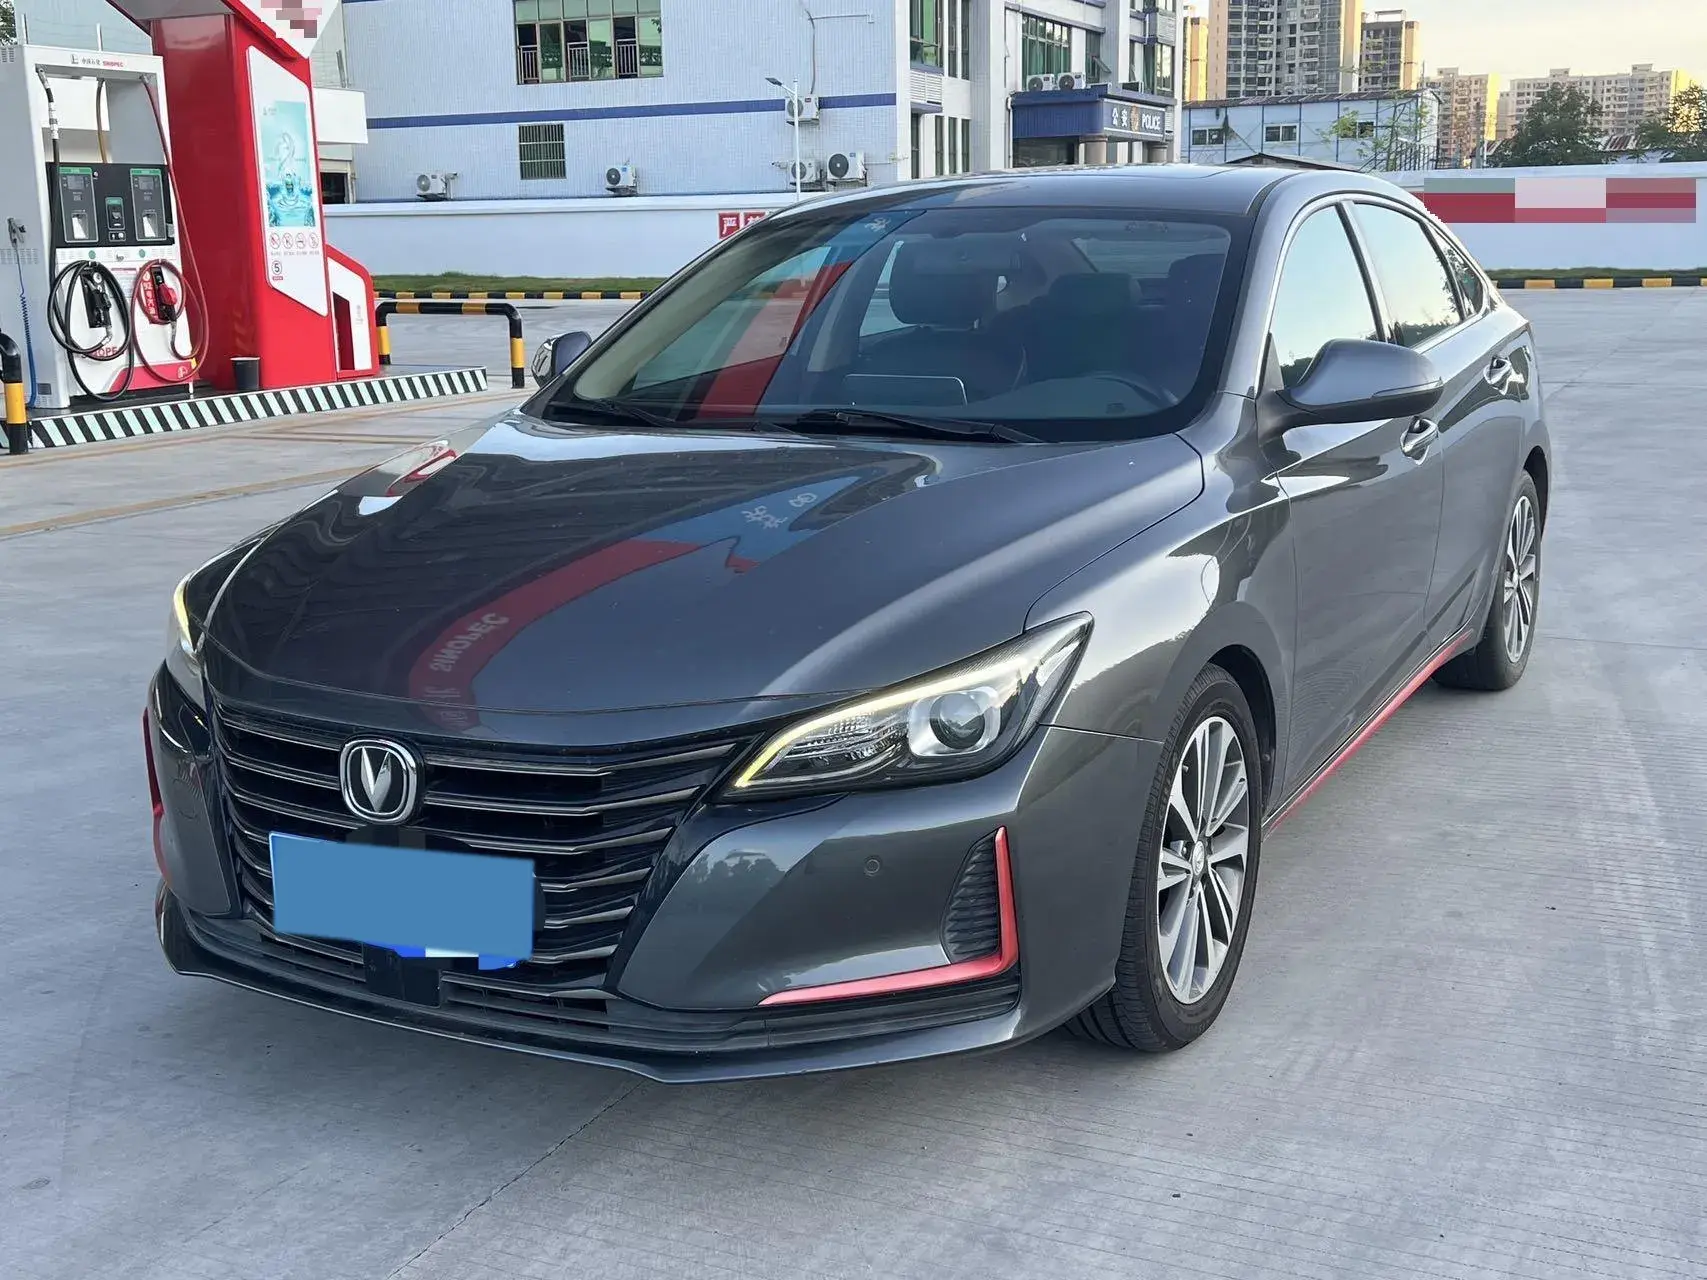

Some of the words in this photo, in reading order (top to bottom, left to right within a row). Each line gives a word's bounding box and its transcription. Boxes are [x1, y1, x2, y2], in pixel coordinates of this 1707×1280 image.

[1112, 107, 1128, 127] 公安
[1141, 113, 1161, 130] POLICE
[274, 262, 280, 273] 5
